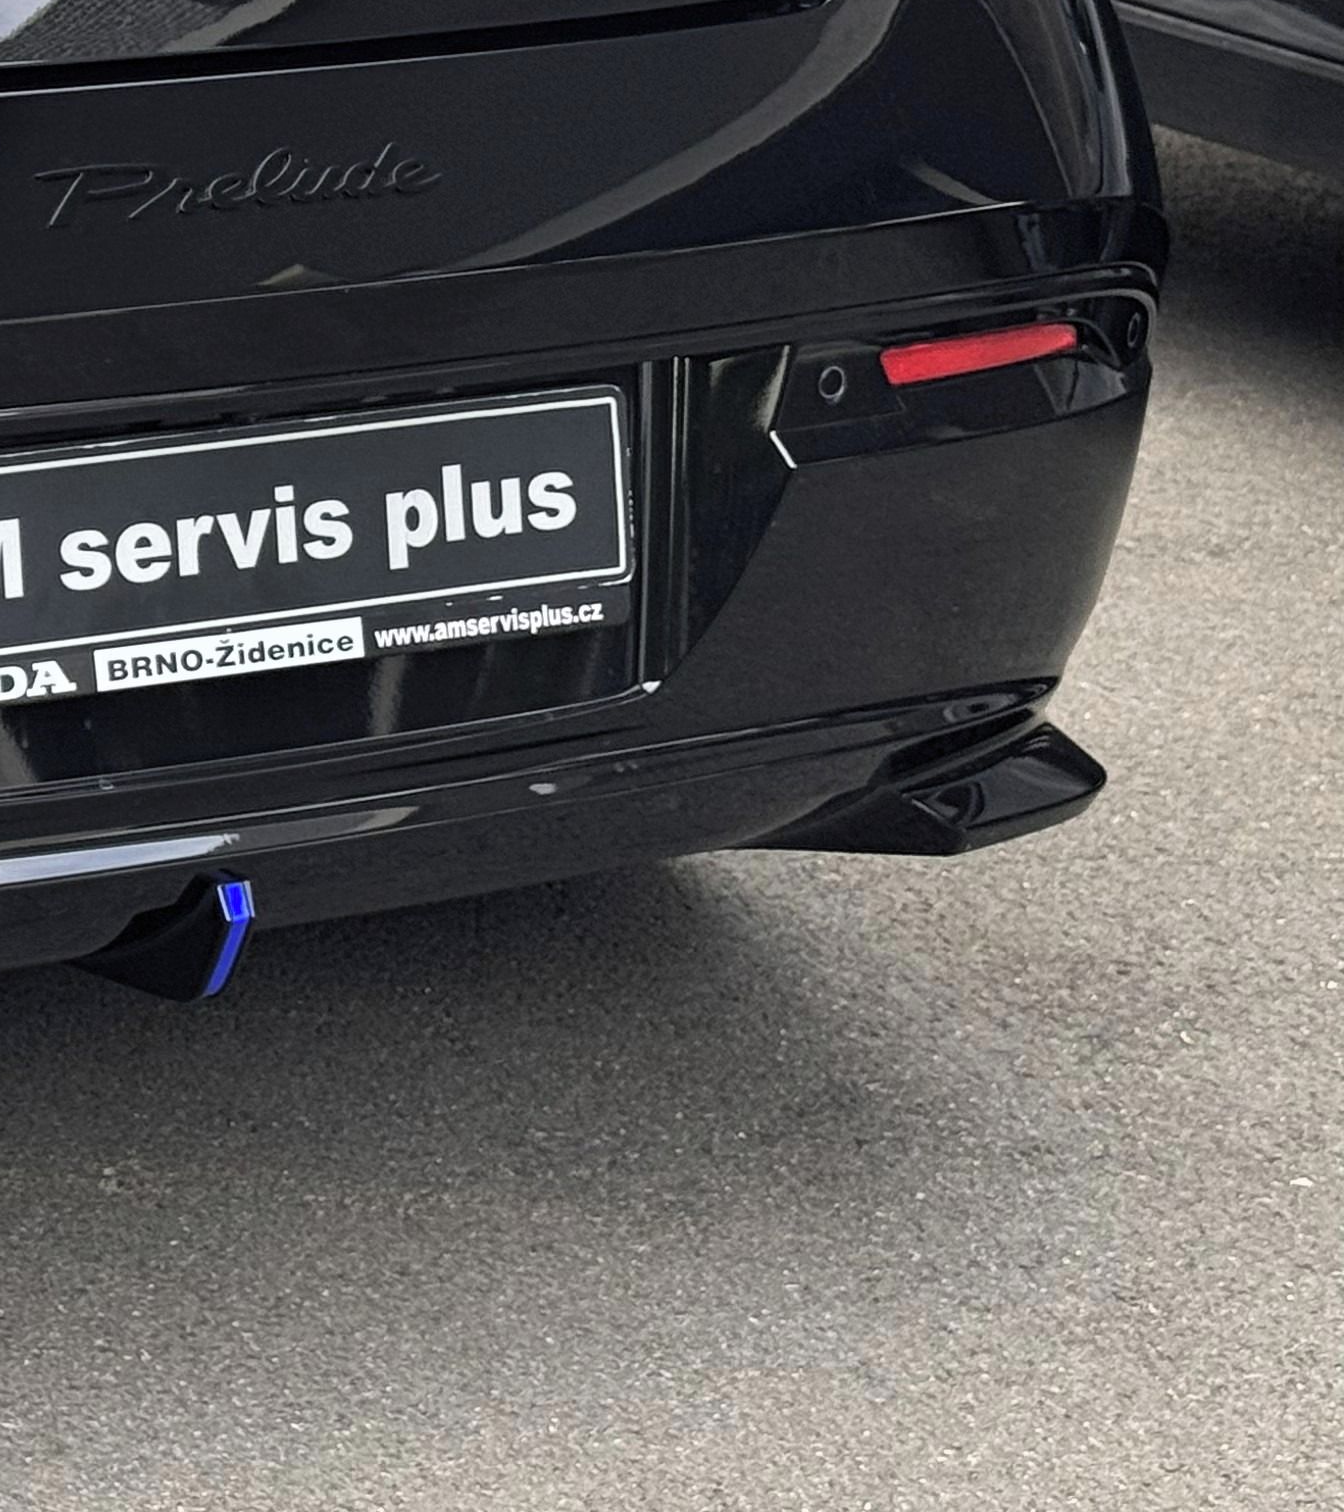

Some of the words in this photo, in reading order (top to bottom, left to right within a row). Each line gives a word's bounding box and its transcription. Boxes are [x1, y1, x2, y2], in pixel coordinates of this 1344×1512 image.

[33, 141, 444, 228] Prelude
[59, 484, 354, 591] servis
[385, 463, 577, 571] plus
[107, 635, 354, 682] BRNO-Židenice
[374, 603, 605, 648] www.amservisplus.cz
